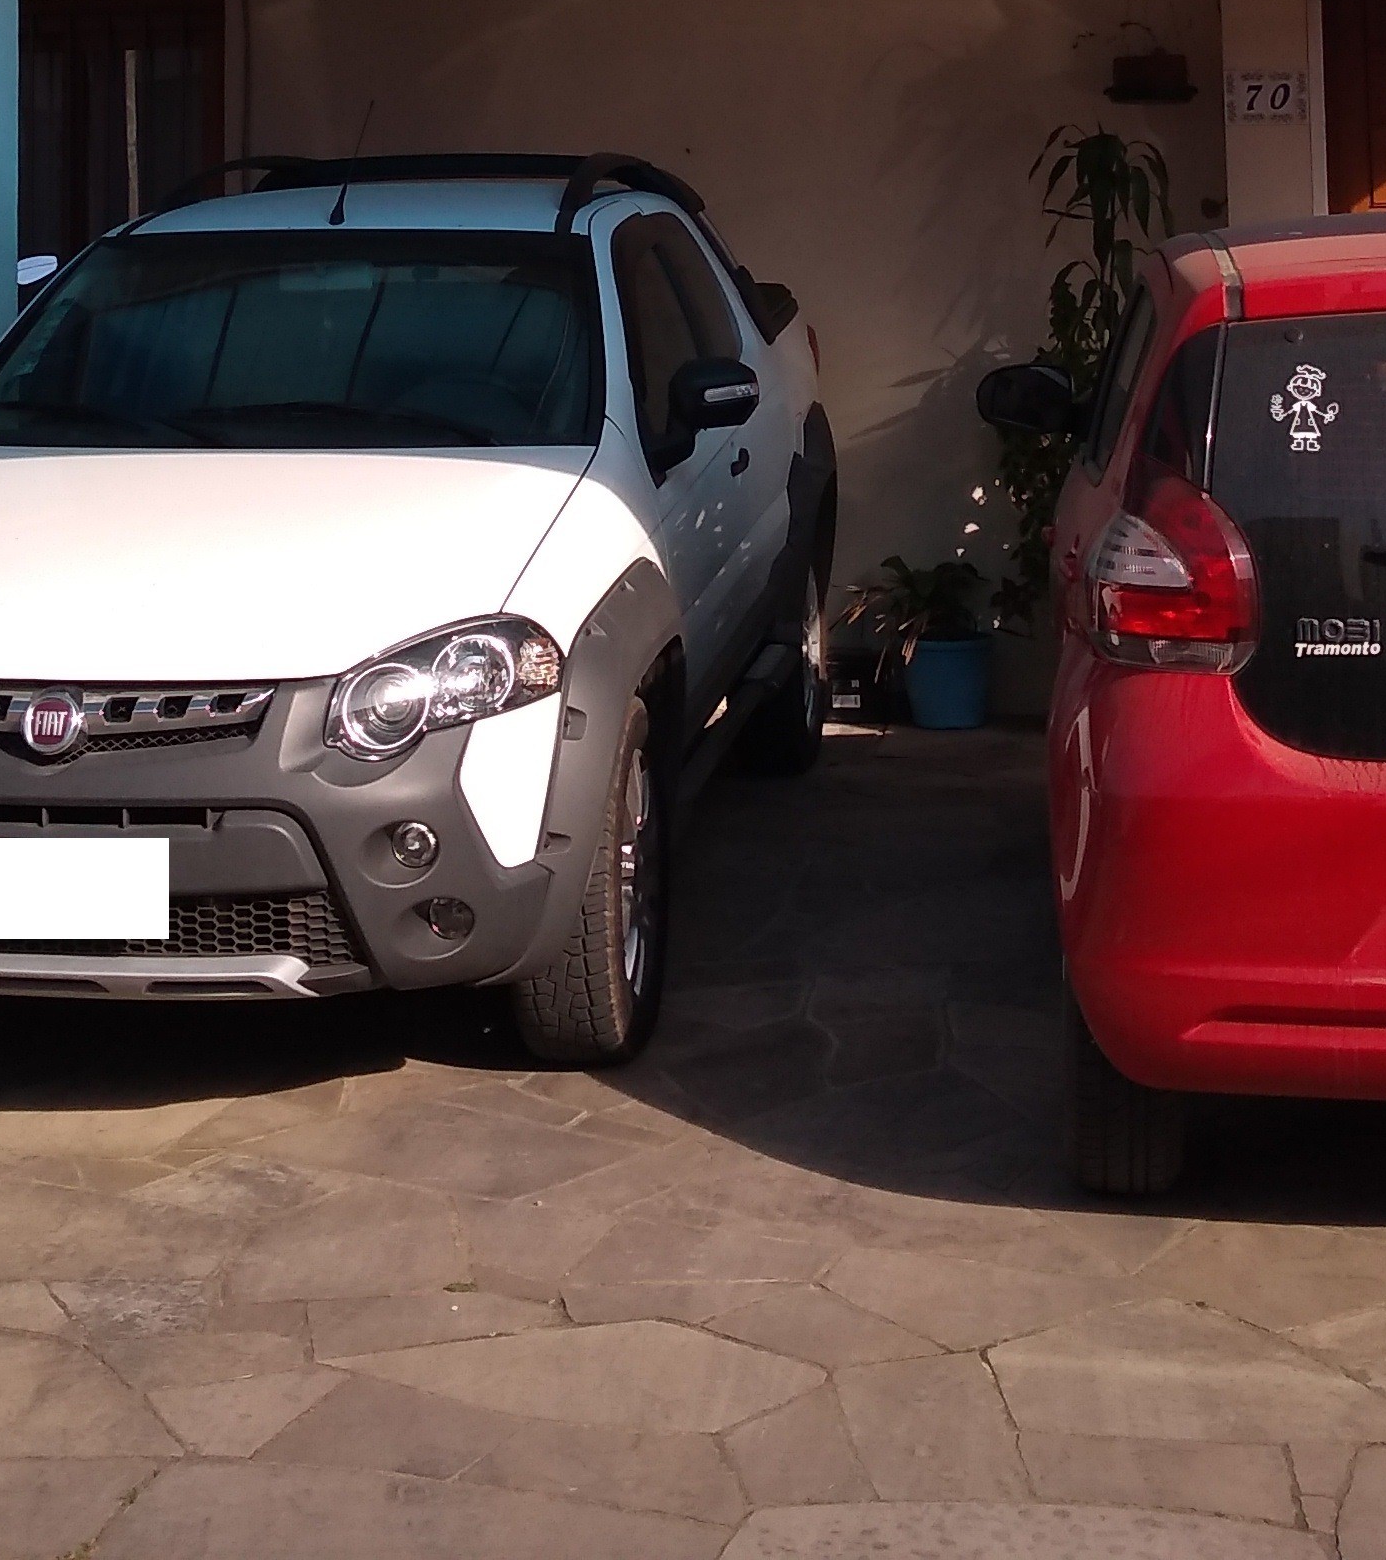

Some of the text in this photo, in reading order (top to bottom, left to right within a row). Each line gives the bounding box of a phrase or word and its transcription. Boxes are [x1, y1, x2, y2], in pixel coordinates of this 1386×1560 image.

[1246, 83, 1291, 111] 70
[1296, 617, 1380, 642] MOBI
[1294, 641, 1381, 658] Tramonto
[34, 710, 69, 736] FIAT
